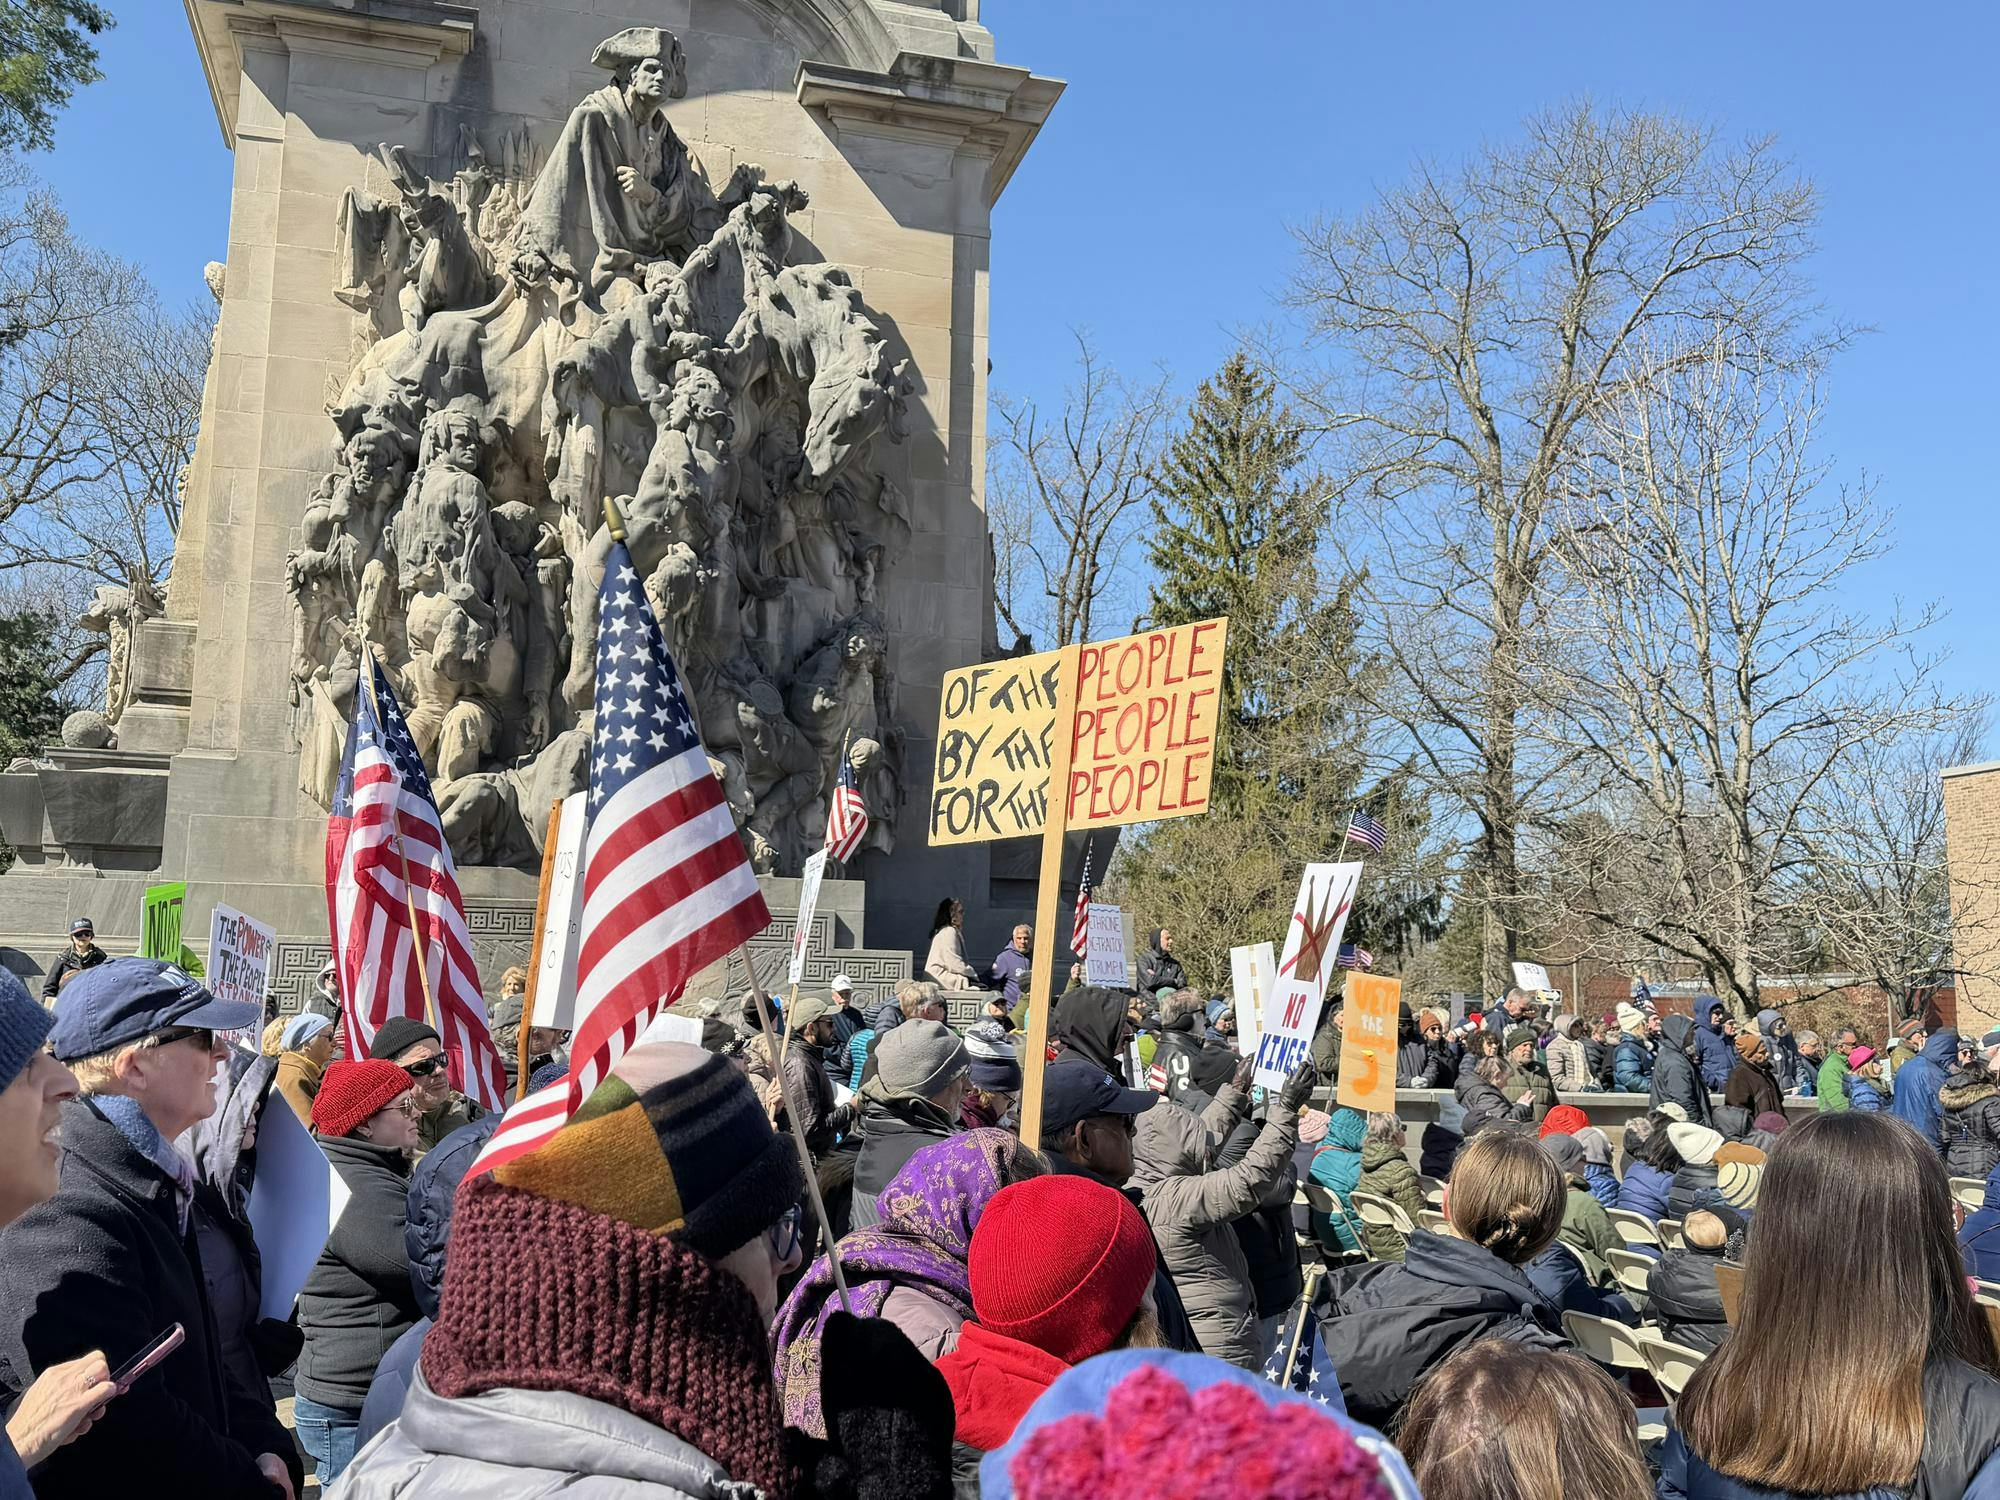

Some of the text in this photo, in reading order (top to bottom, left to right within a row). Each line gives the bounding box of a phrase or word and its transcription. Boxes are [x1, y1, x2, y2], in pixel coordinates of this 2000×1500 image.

[1077, 623, 1218, 702] PEOPLE
[945, 668, 996, 720] OF
[1071, 687, 1215, 764] PEOPLE
[938, 724, 993, 783] BY
[932, 778, 1002, 838] FOR
[1067, 751, 1210, 821] PEOPLE
[219, 915, 237, 946] THE
[235, 915, 266, 960] POWER
[1089, 915, 1121, 933] ETHRONE
[220, 949, 240, 985] THE
[239, 958, 266, 995] PEOPLE
[1281, 992, 1307, 1030] NO
[1256, 1033, 1307, 1074] KINGS
